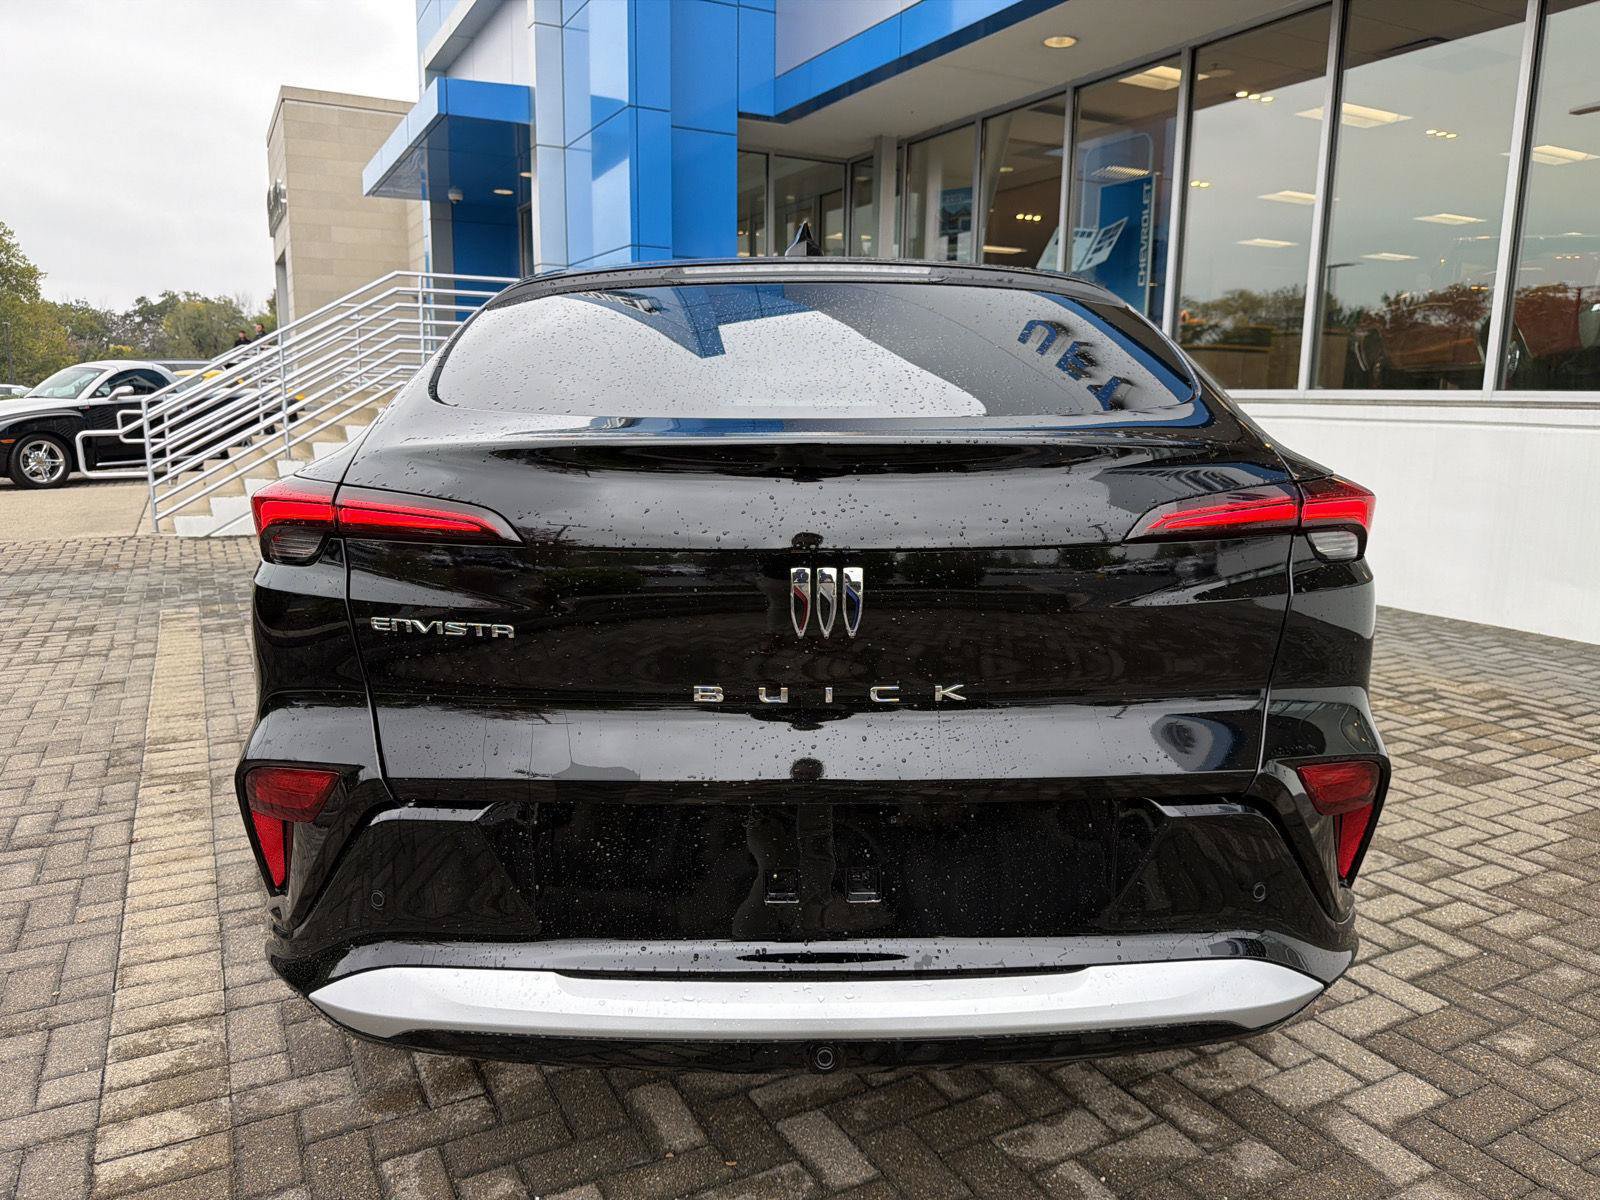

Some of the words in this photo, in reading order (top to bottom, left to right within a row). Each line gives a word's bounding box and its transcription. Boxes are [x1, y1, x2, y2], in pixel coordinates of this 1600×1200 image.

[1137, 183, 1152, 287] CHEVROLET
[370, 616, 515, 639] ENVISTA
[693, 684, 967, 703] BUICK
